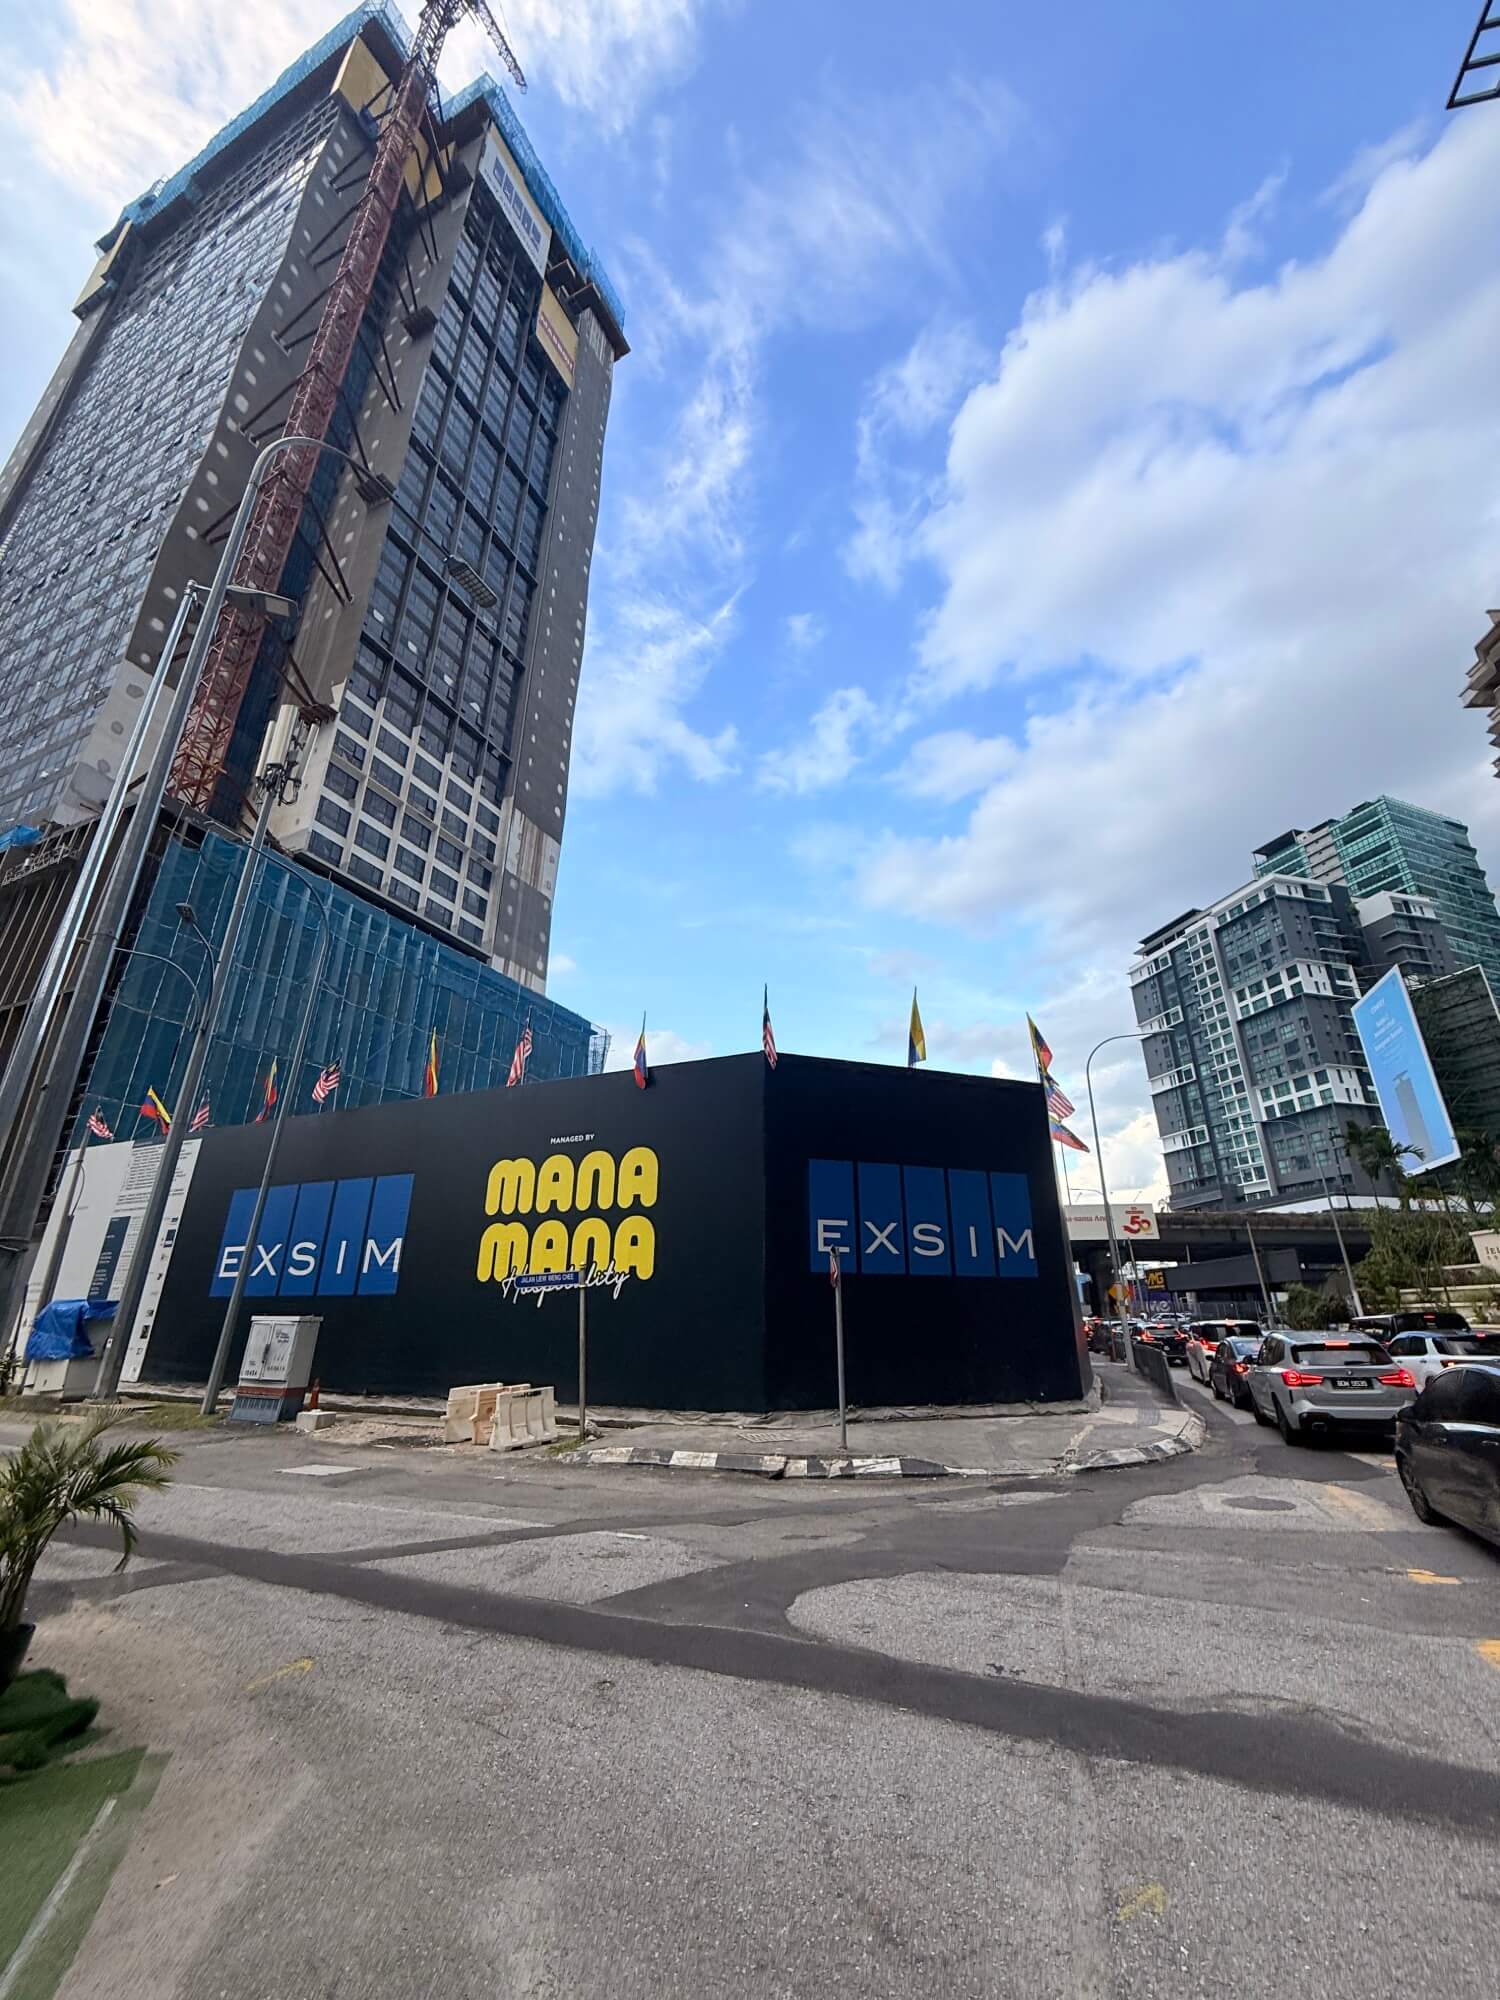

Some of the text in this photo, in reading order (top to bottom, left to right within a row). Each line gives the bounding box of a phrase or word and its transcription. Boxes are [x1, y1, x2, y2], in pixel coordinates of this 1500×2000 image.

[550, 1133, 595, 1145] MANAGED BY
[484, 1147, 659, 1216] MANA
[218, 1237, 403, 1278] EXSIM
[476, 1215, 656, 1282] MANA
[816, 1219, 1035, 1260] EXSIM
